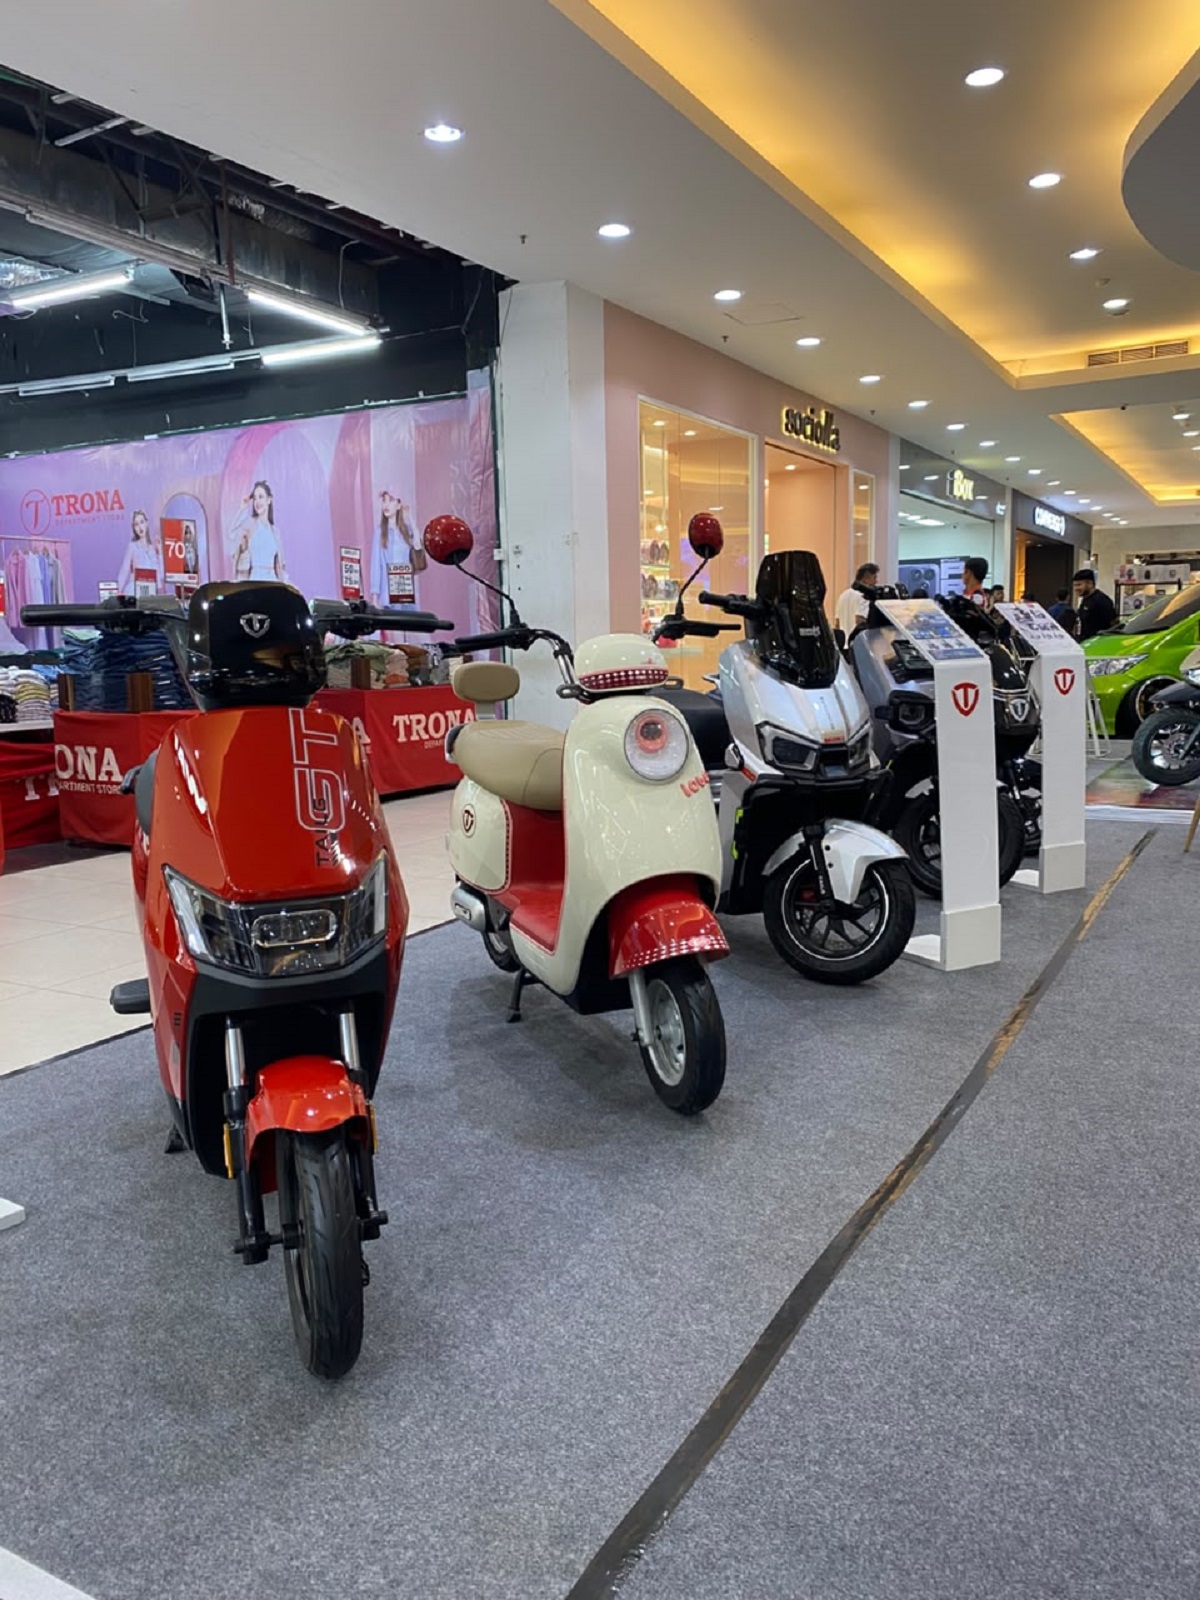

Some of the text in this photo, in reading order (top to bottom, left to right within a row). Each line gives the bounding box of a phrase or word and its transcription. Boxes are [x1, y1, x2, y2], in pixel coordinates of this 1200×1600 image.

[783, 407, 840, 452] sociolla
[51, 489, 125, 516] TRONA
[164, 541, 185, 558] 70
